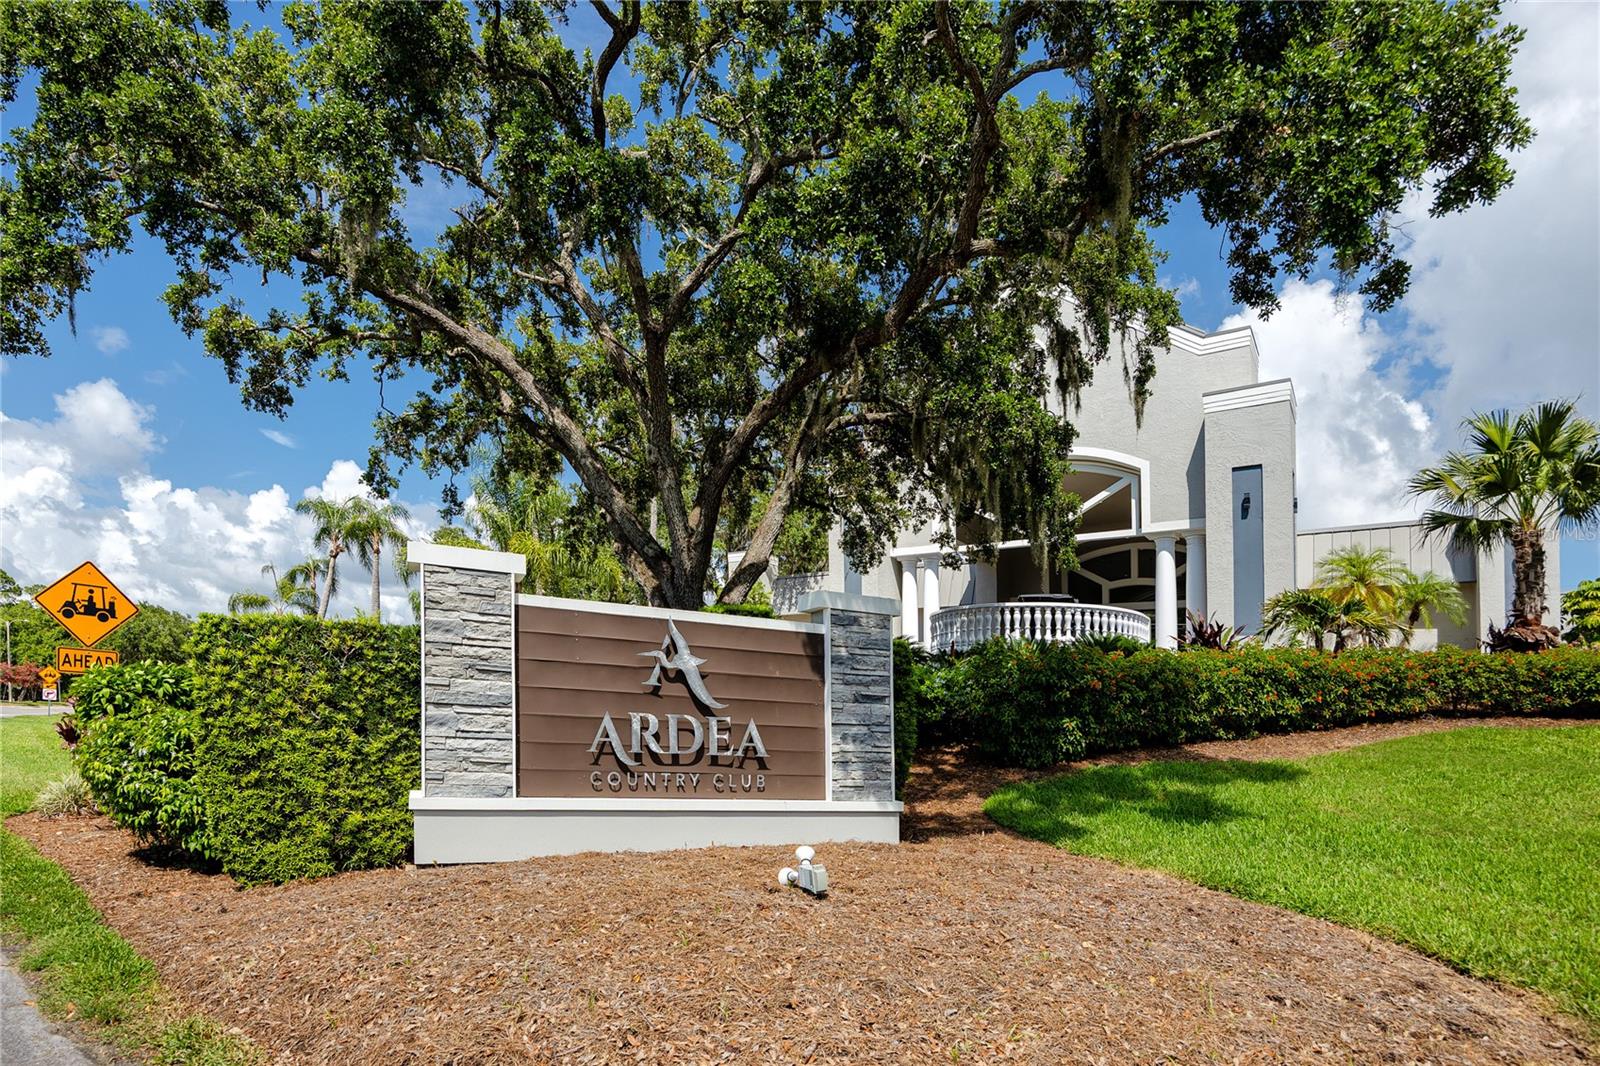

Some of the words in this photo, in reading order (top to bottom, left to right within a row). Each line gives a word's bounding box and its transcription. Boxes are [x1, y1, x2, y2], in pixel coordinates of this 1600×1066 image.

[61, 653, 114, 669] AHEAD
[586, 711, 771, 766] ARDEA
[590, 771, 700, 787] COUNTRY
[713, 773, 766, 788] CLUB
